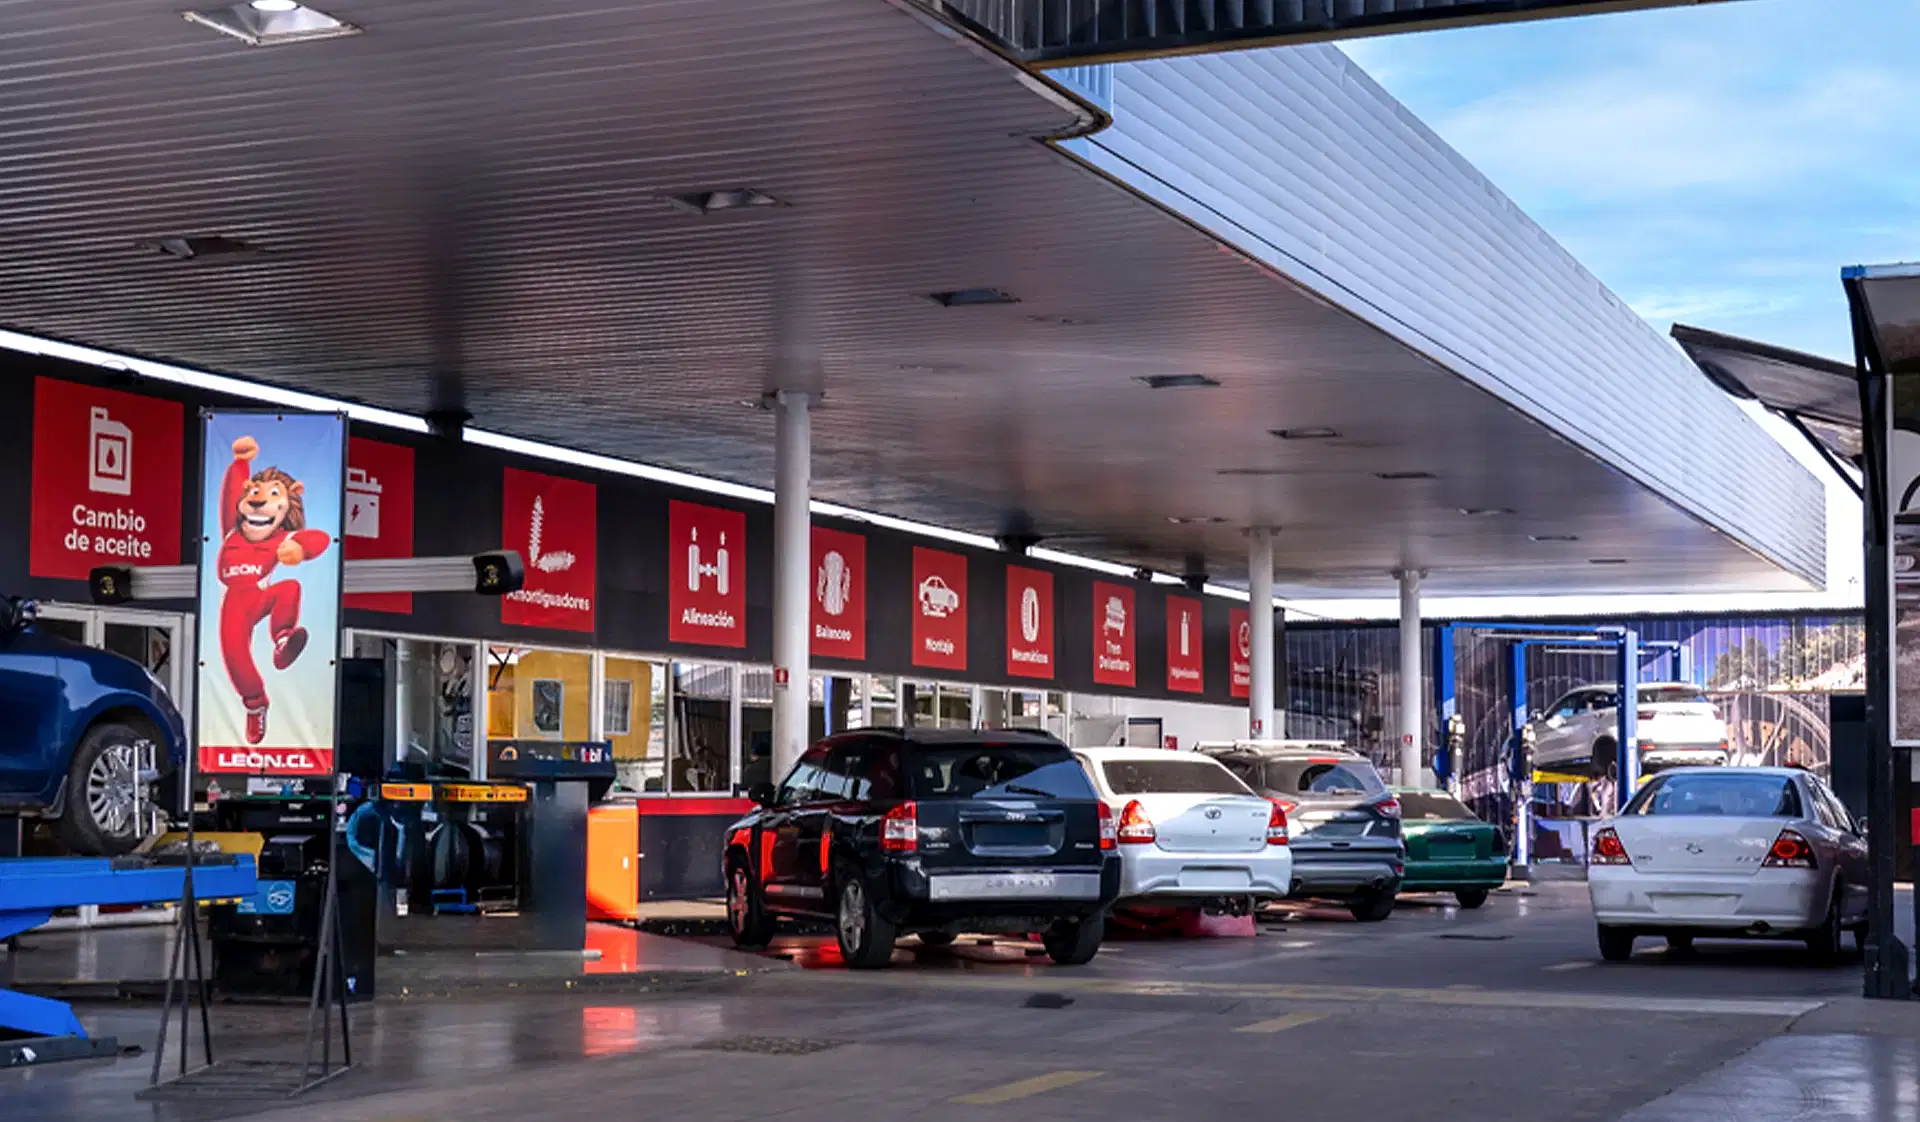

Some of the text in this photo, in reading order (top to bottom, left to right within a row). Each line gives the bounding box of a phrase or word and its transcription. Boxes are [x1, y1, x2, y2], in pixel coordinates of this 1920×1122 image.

[72, 504, 146, 532] Cambio
[64, 529, 152, 558] de aceite
[222, 564, 262, 577] LEON
[681, 607, 736, 629] Alineación
[815, 623, 852, 642] Balanceo
[218, 751, 314, 769] LEON.CL
